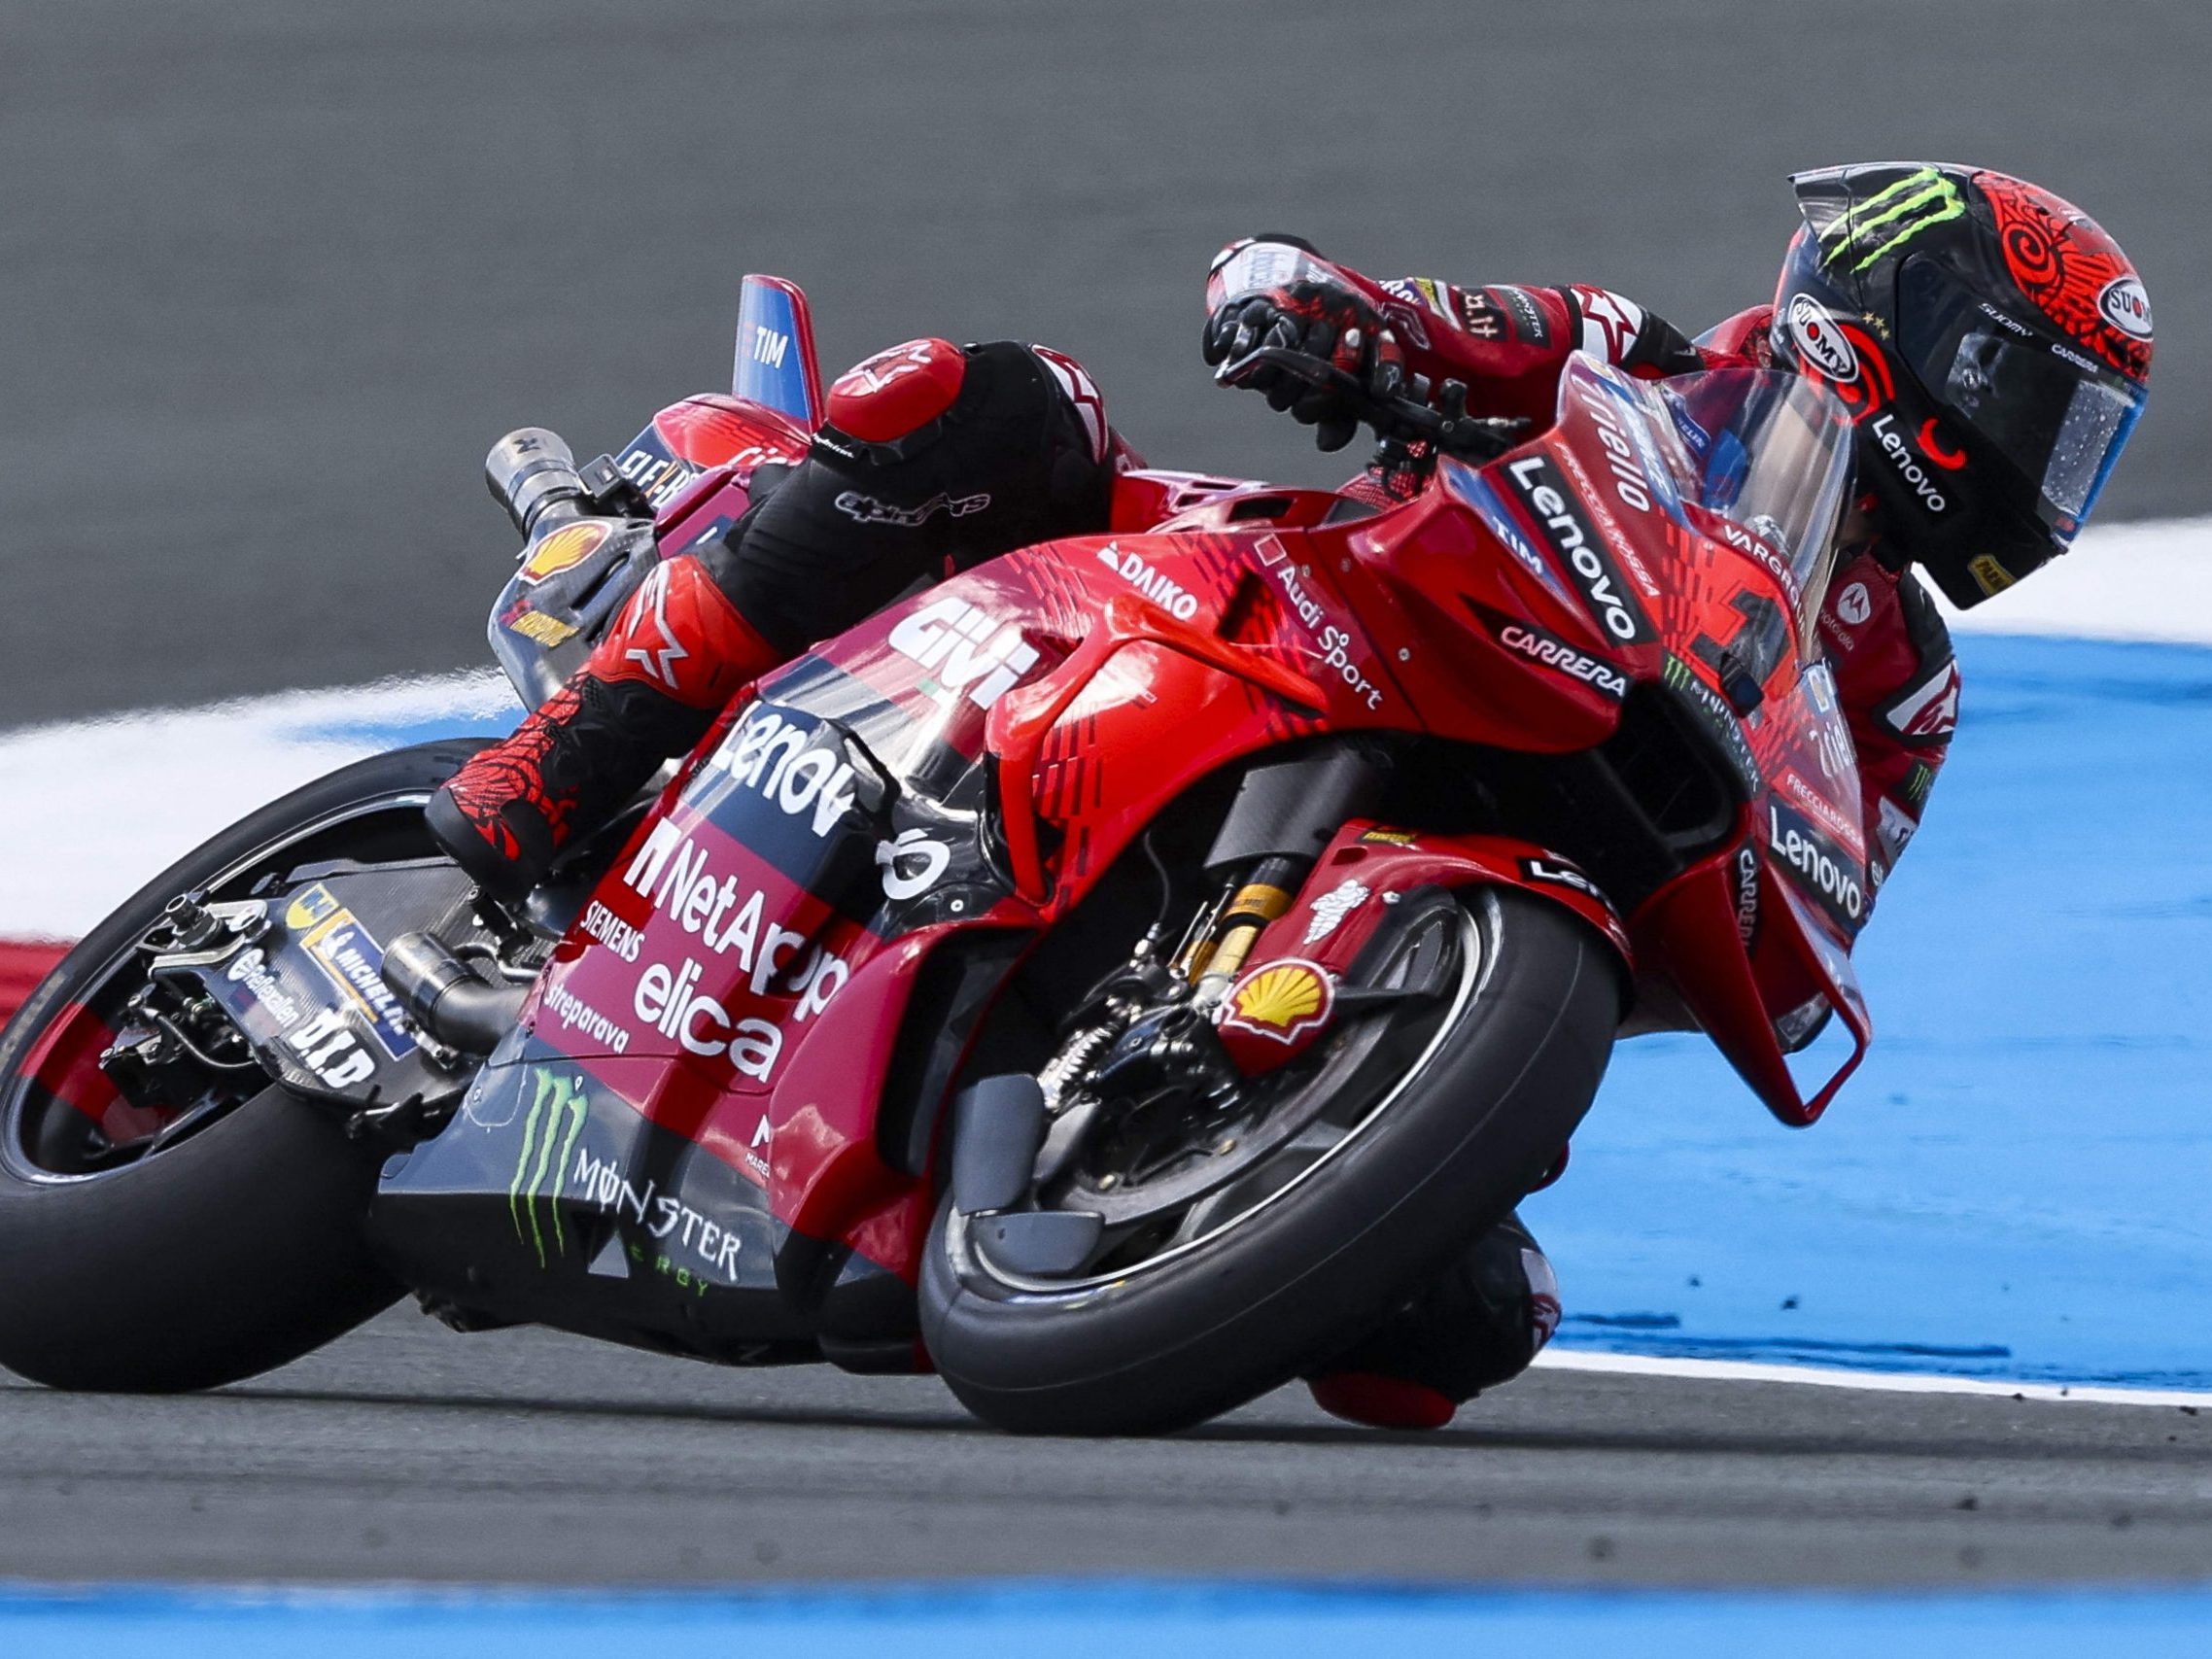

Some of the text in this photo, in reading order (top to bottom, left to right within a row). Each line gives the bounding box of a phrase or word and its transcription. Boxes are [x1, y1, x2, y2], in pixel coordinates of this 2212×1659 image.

[1796, 299, 1849, 378] SUOMY
[1978, 303, 2099, 374] SUOMY CARRERA
[2110, 288, 2151, 325] SUO
[754, 326, 788, 369] TIM
[1872, 414, 1946, 513] Lenovo
[1493, 516, 1544, 574] TIM
[1508, 457, 1636, 640] Lenovo
[1119, 553, 1198, 621] DAIKO
[1278, 566, 1384, 710] Audi Sport
[1501, 626, 1627, 698] CARRERA
[1770, 805, 1861, 919] Lenovo
[579, 900, 645, 963] SIEMENS
[653, 838, 850, 1022] NetApp
[336, 947, 407, 1036] MICHELIN
[543, 984, 630, 1054] streparava
[634, 956, 783, 1084] elica
